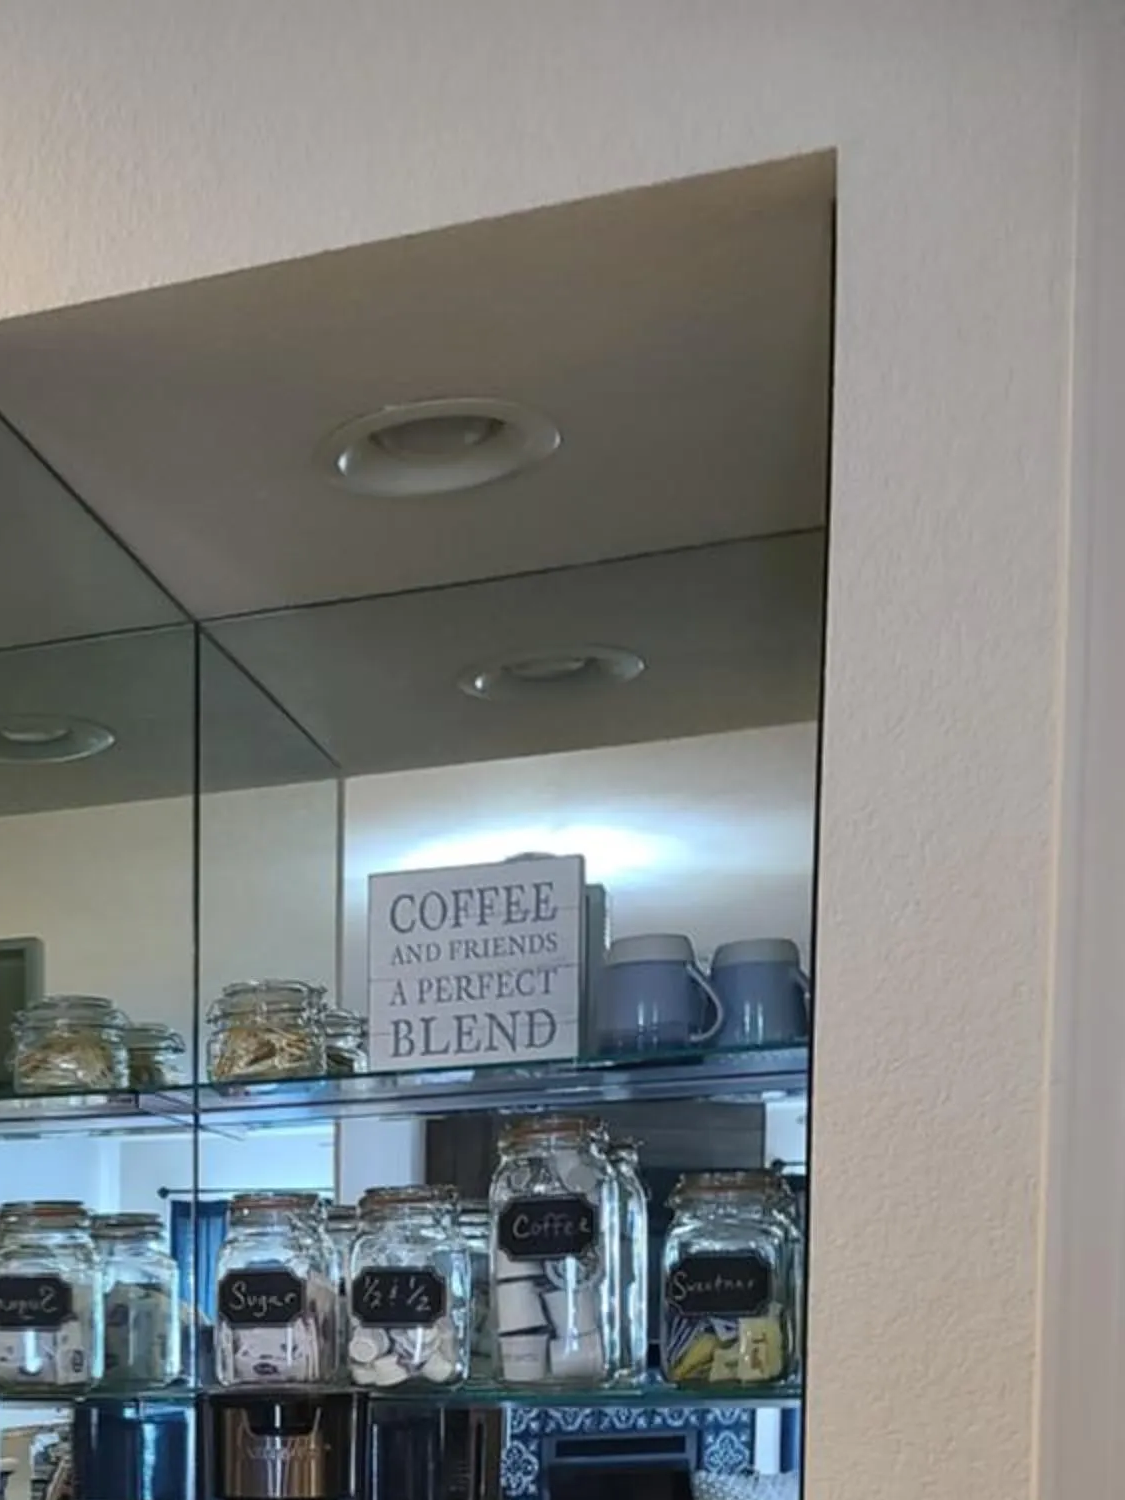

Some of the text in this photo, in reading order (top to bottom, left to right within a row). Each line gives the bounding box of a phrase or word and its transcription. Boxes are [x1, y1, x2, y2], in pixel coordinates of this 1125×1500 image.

[390, 881, 559, 934] COFFEE
[391, 931, 559, 967] AND FRIENDS
[389, 966, 559, 1007] A PERFECT
[390, 1007, 558, 1059] BLEND
[512, 1212, 592, 1239] Coffee
[227, 1280, 297, 1319] Sugar
